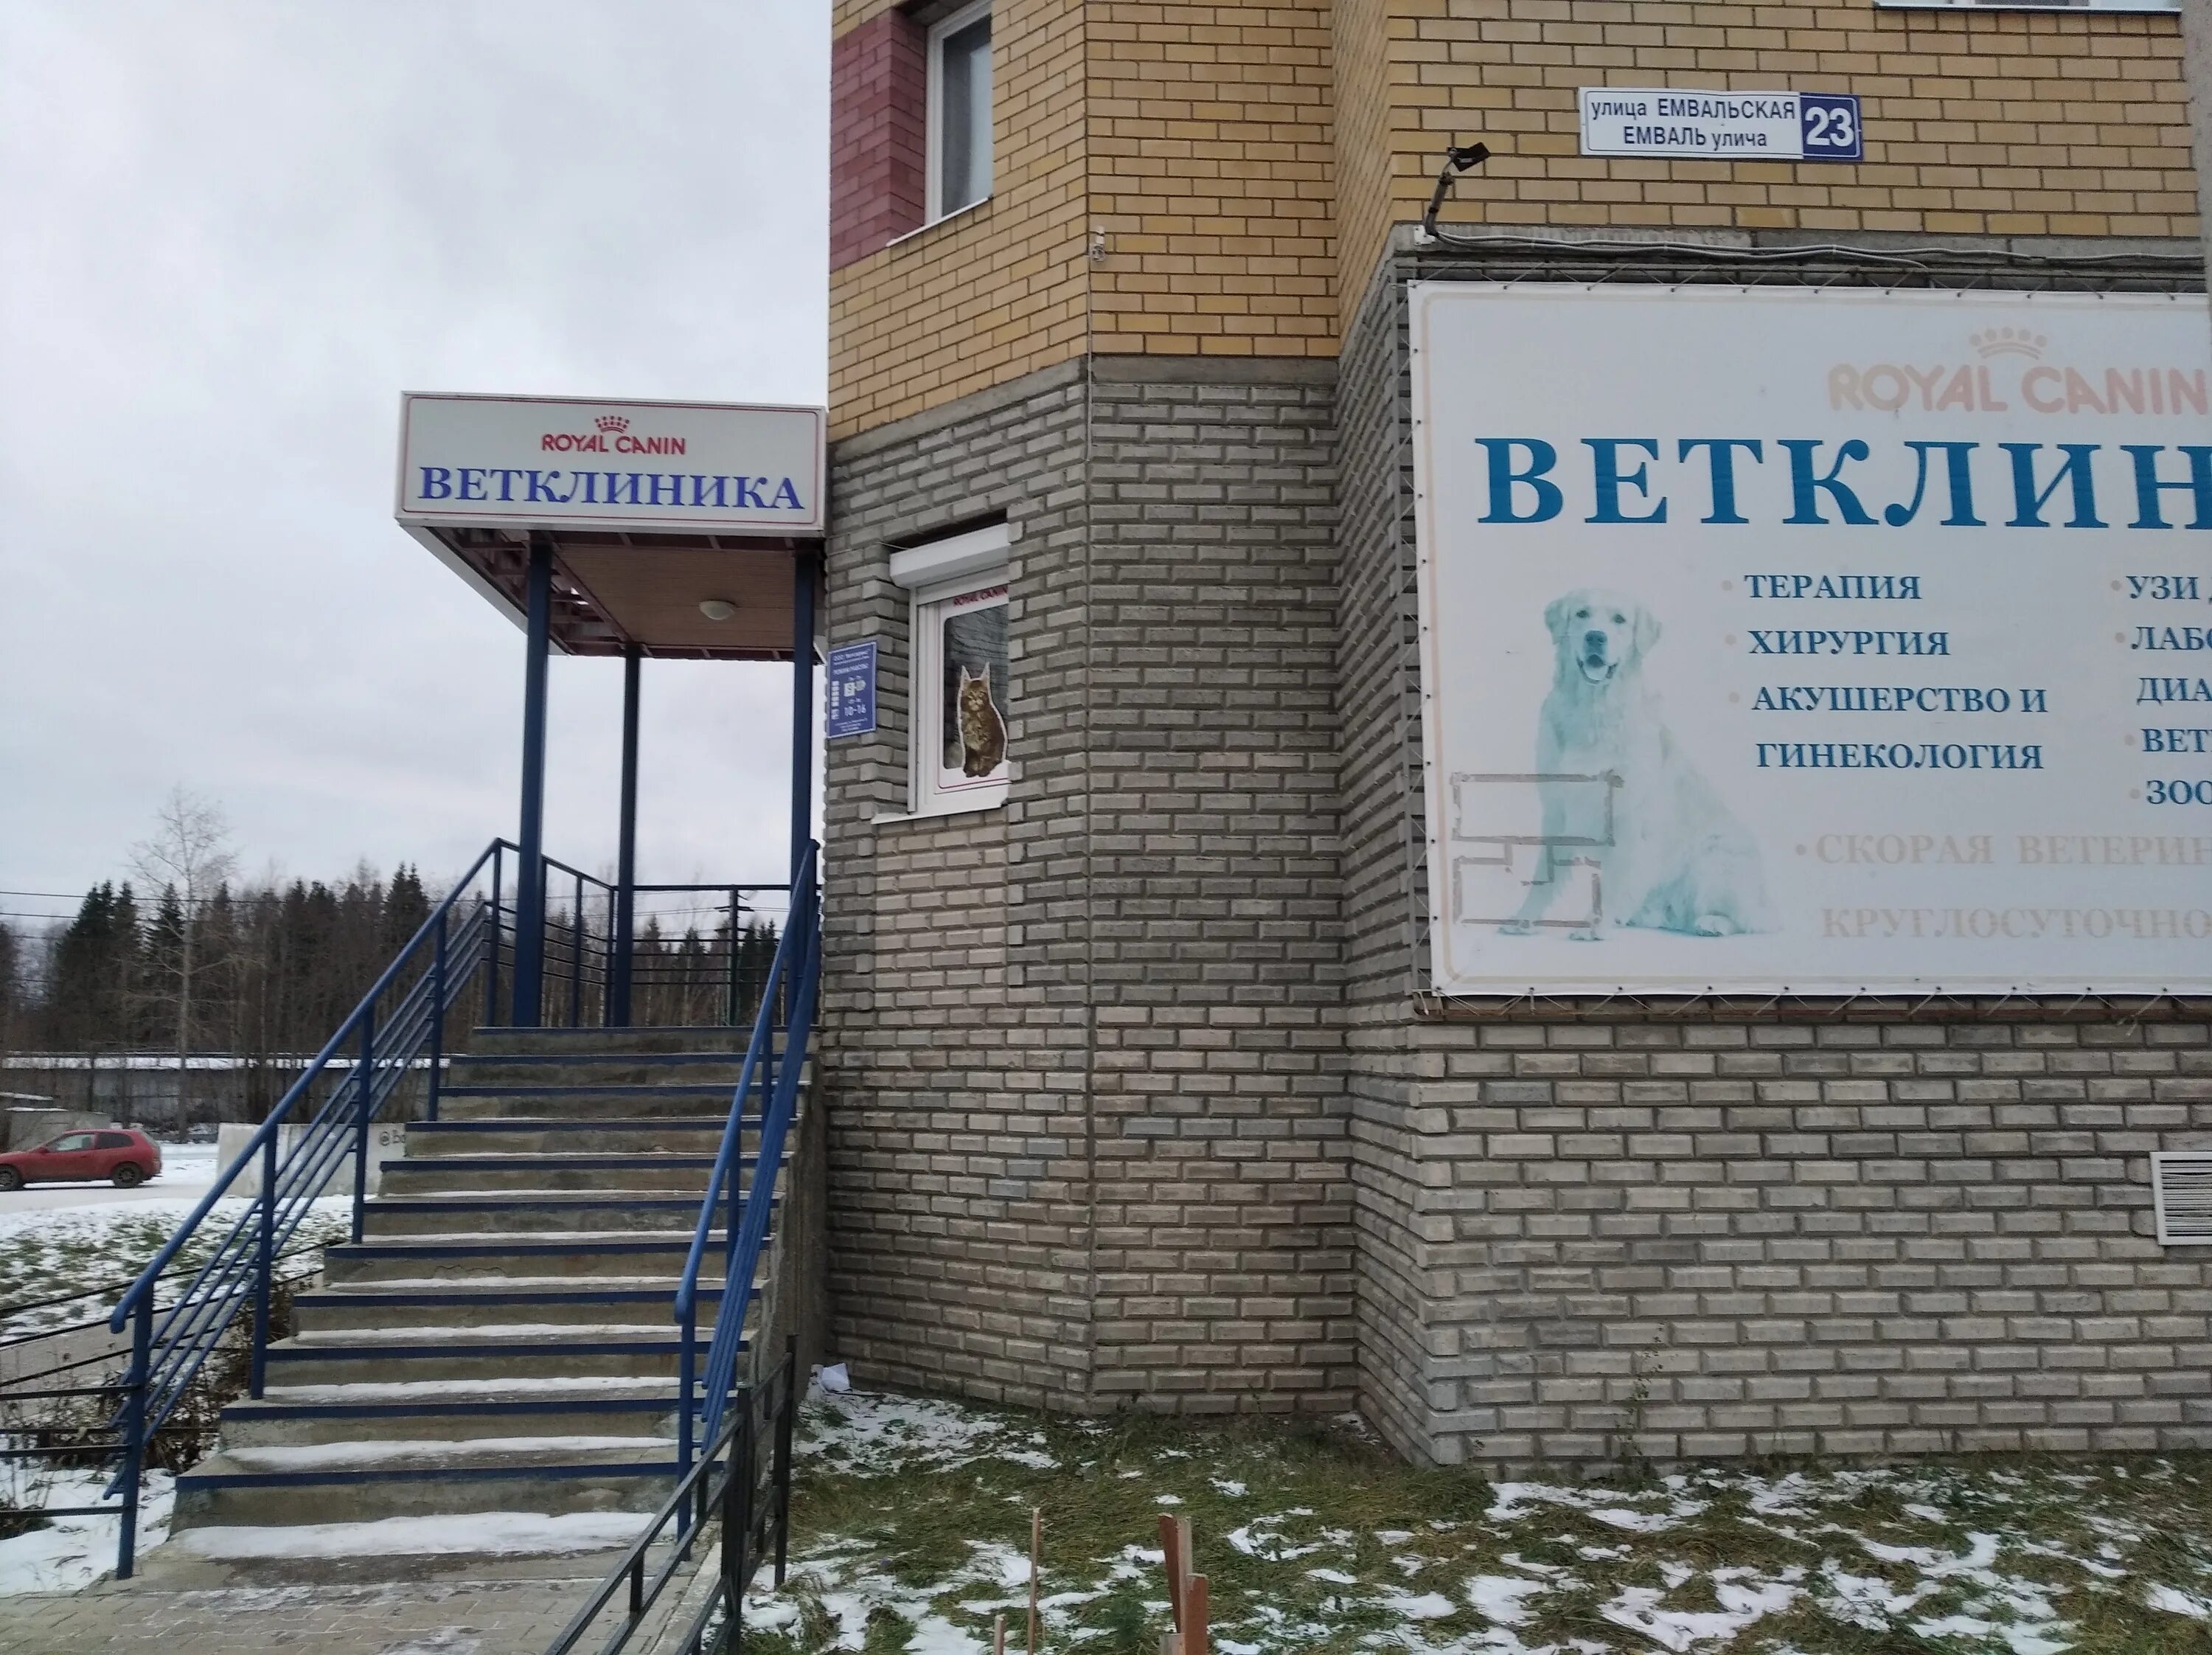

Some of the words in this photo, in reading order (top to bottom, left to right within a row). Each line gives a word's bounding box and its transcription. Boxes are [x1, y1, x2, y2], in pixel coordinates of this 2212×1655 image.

[1591, 100, 1647, 120] улица
[1658, 98, 1795, 119] ЕМВАЛЬСКАЯ
[1624, 125, 1706, 146] ЕМВАЛЬ
[1711, 130, 1767, 151] улича
[1804, 106, 1854, 147] 23
[1827, 364, 2007, 412] ROYAL
[2020, 366, 2208, 414] CANIN
[542, 434, 609, 454] ROYAL
[615, 435, 686, 455] CANIN
[417, 466, 806, 510] ВЕТКЛИНИКА
[1475, 437, 2212, 530] ВЕТКЛИН
[1744, 575, 1922, 600] ТЕРАПИЯ
[2126, 575, 2200, 600] УЗИ
[1748, 631, 1951, 656] ХИРУРГИЯ
[2131, 626, 2212, 650] ЛАБ
[1751, 687, 2010, 712] АКУШЕРСТВО
[2020, 689, 2048, 712] И
[2141, 729, 2212, 752] ВЕТ
[1756, 743, 2044, 768] ГИНЕКОЛОГИЯ
[1817, 835, 1994, 864] СКОРАЯ
[1822, 909, 2212, 939] КРУГЛОСУТОЧНО
